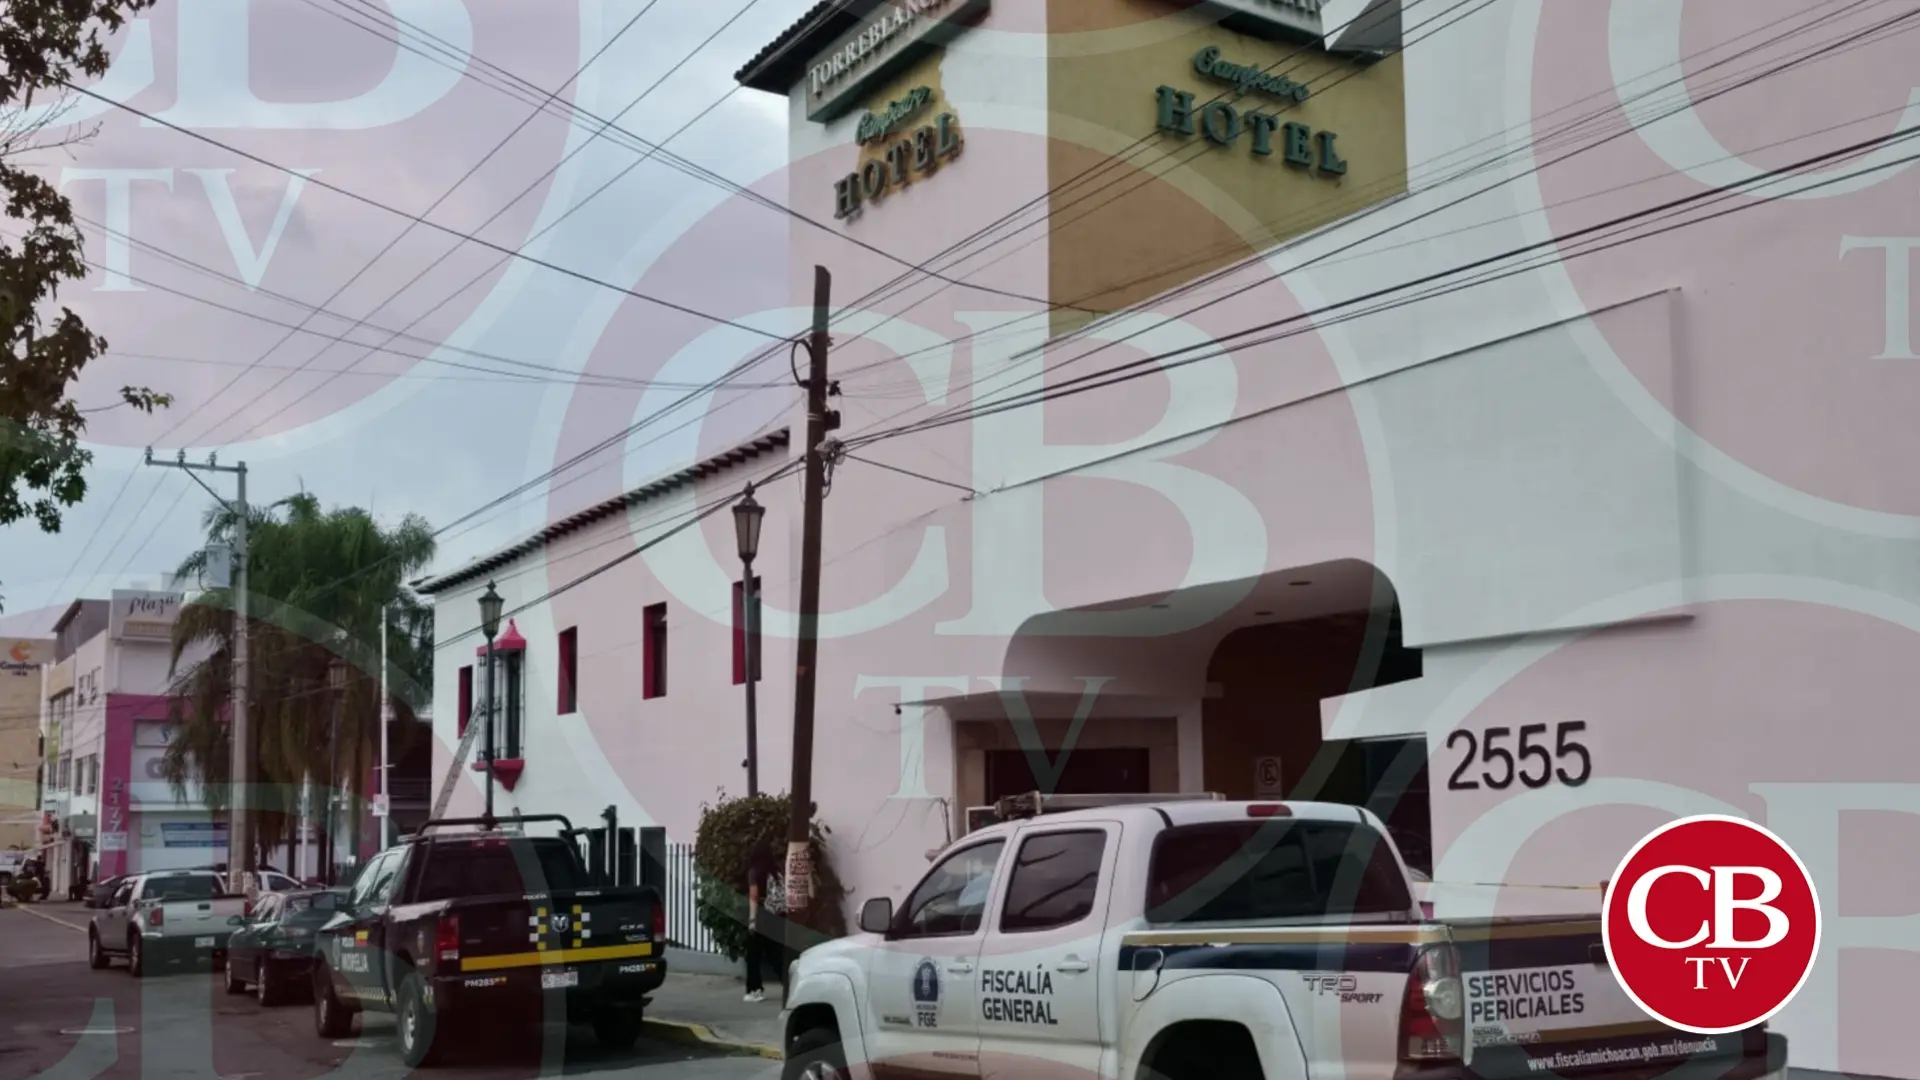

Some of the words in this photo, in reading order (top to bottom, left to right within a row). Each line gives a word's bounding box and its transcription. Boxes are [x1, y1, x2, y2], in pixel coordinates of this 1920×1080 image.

[809, 0, 936, 94] TORREBLAN
[1156, 85, 1347, 174] HOTEL
[833, 112, 960, 220] HOTEL
[1446, 720, 1592, 790] 2555
[982, 964, 1053, 995] FISCALÍA
[1303, 975, 1358, 996] TRD
[1468, 970, 1575, 999] SERVICIOS
[982, 998, 1058, 1025] GENERAL
[1341, 992, 1384, 1004] SPORT
[1470, 993, 1585, 1023] PERICIALES
[917, 1012, 938, 1028] FGE
[1527, 1037, 1718, 1072] www.fiscaliamichoacan.gob.mx/denuncia
